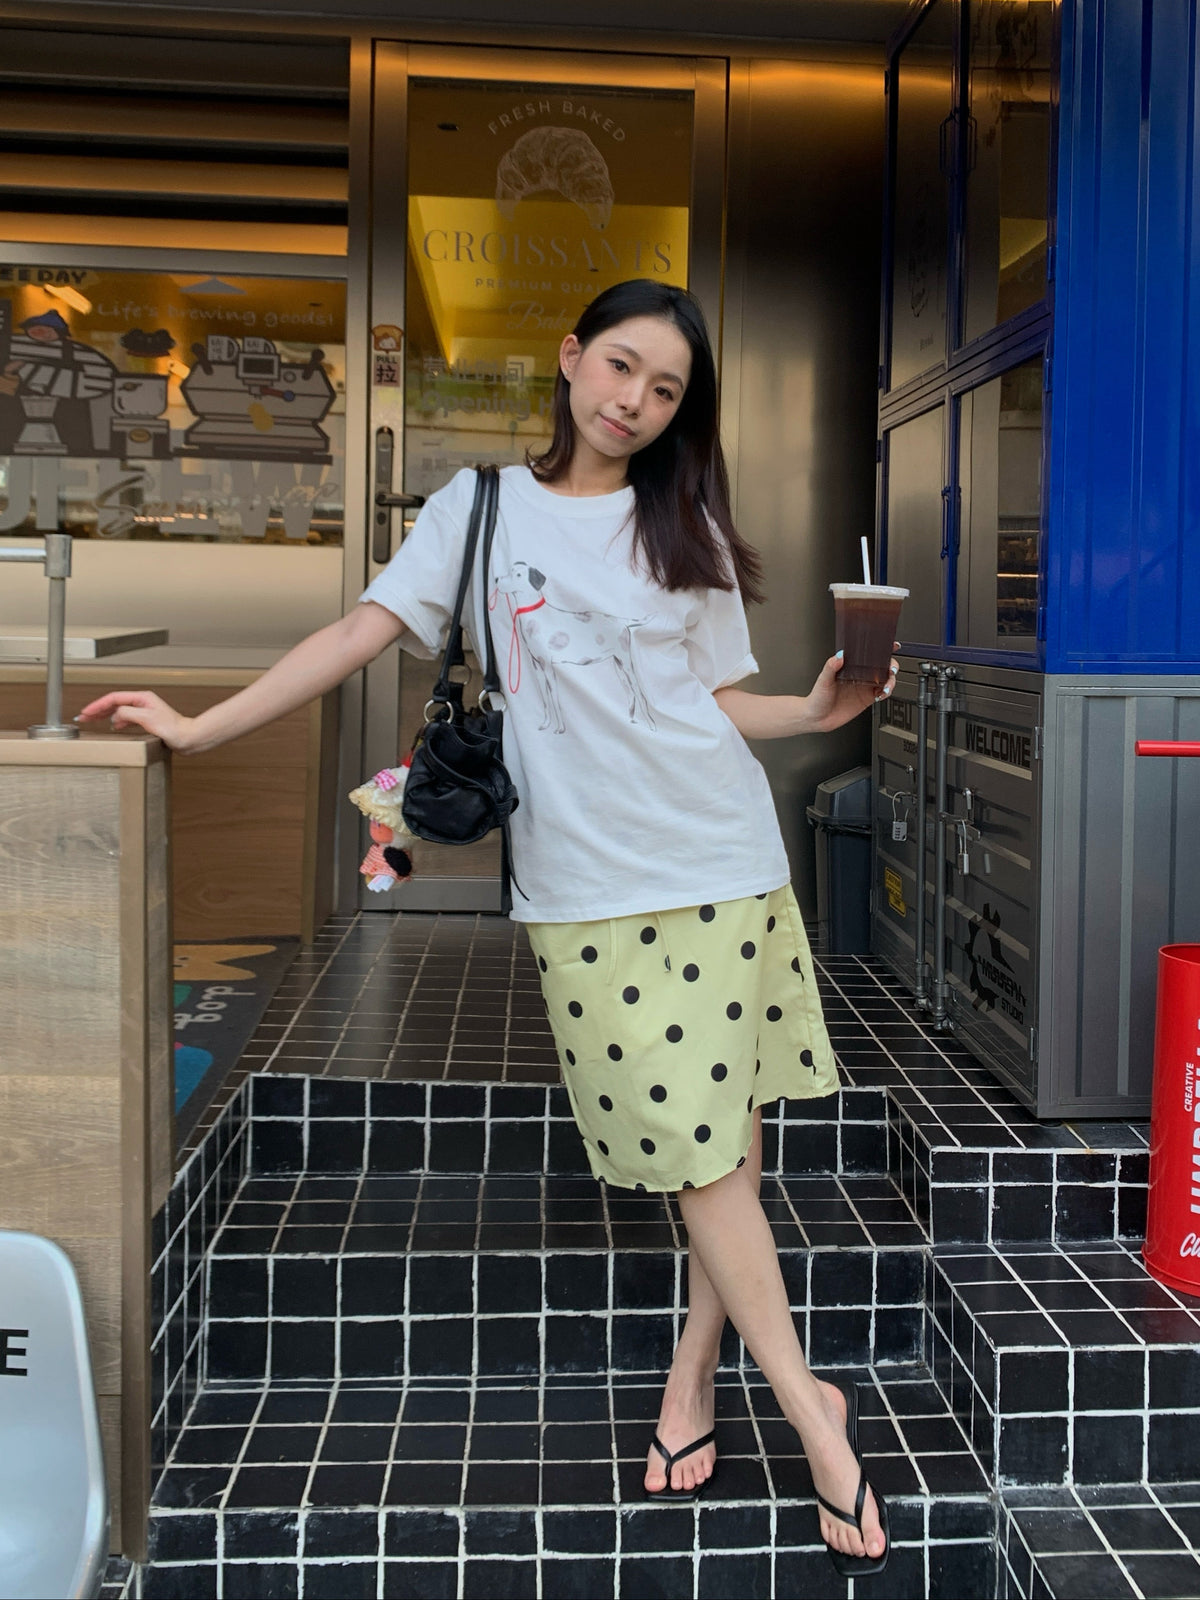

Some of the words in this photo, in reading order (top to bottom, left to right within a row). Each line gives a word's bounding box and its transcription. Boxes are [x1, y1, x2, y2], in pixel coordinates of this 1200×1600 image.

[487, 101, 552, 136] FRESH
[562, 101, 627, 143] BAKED
[423, 228, 673, 274] CROISSANTS
[475, 278, 553, 291] PREMIUM
[561, 281, 603, 294] QUAL
[97, 302, 158, 321] Life's
[168, 304, 257, 327] brewing
[376, 355, 398, 364] PULL
[376, 364, 398, 384] 拉
[422, 391, 531, 421] Opening
[965, 721, 1031, 769] WELCOME
[1184, 1062, 1194, 1113] CREATIVE
[0, 1329, 29, 1377] E
